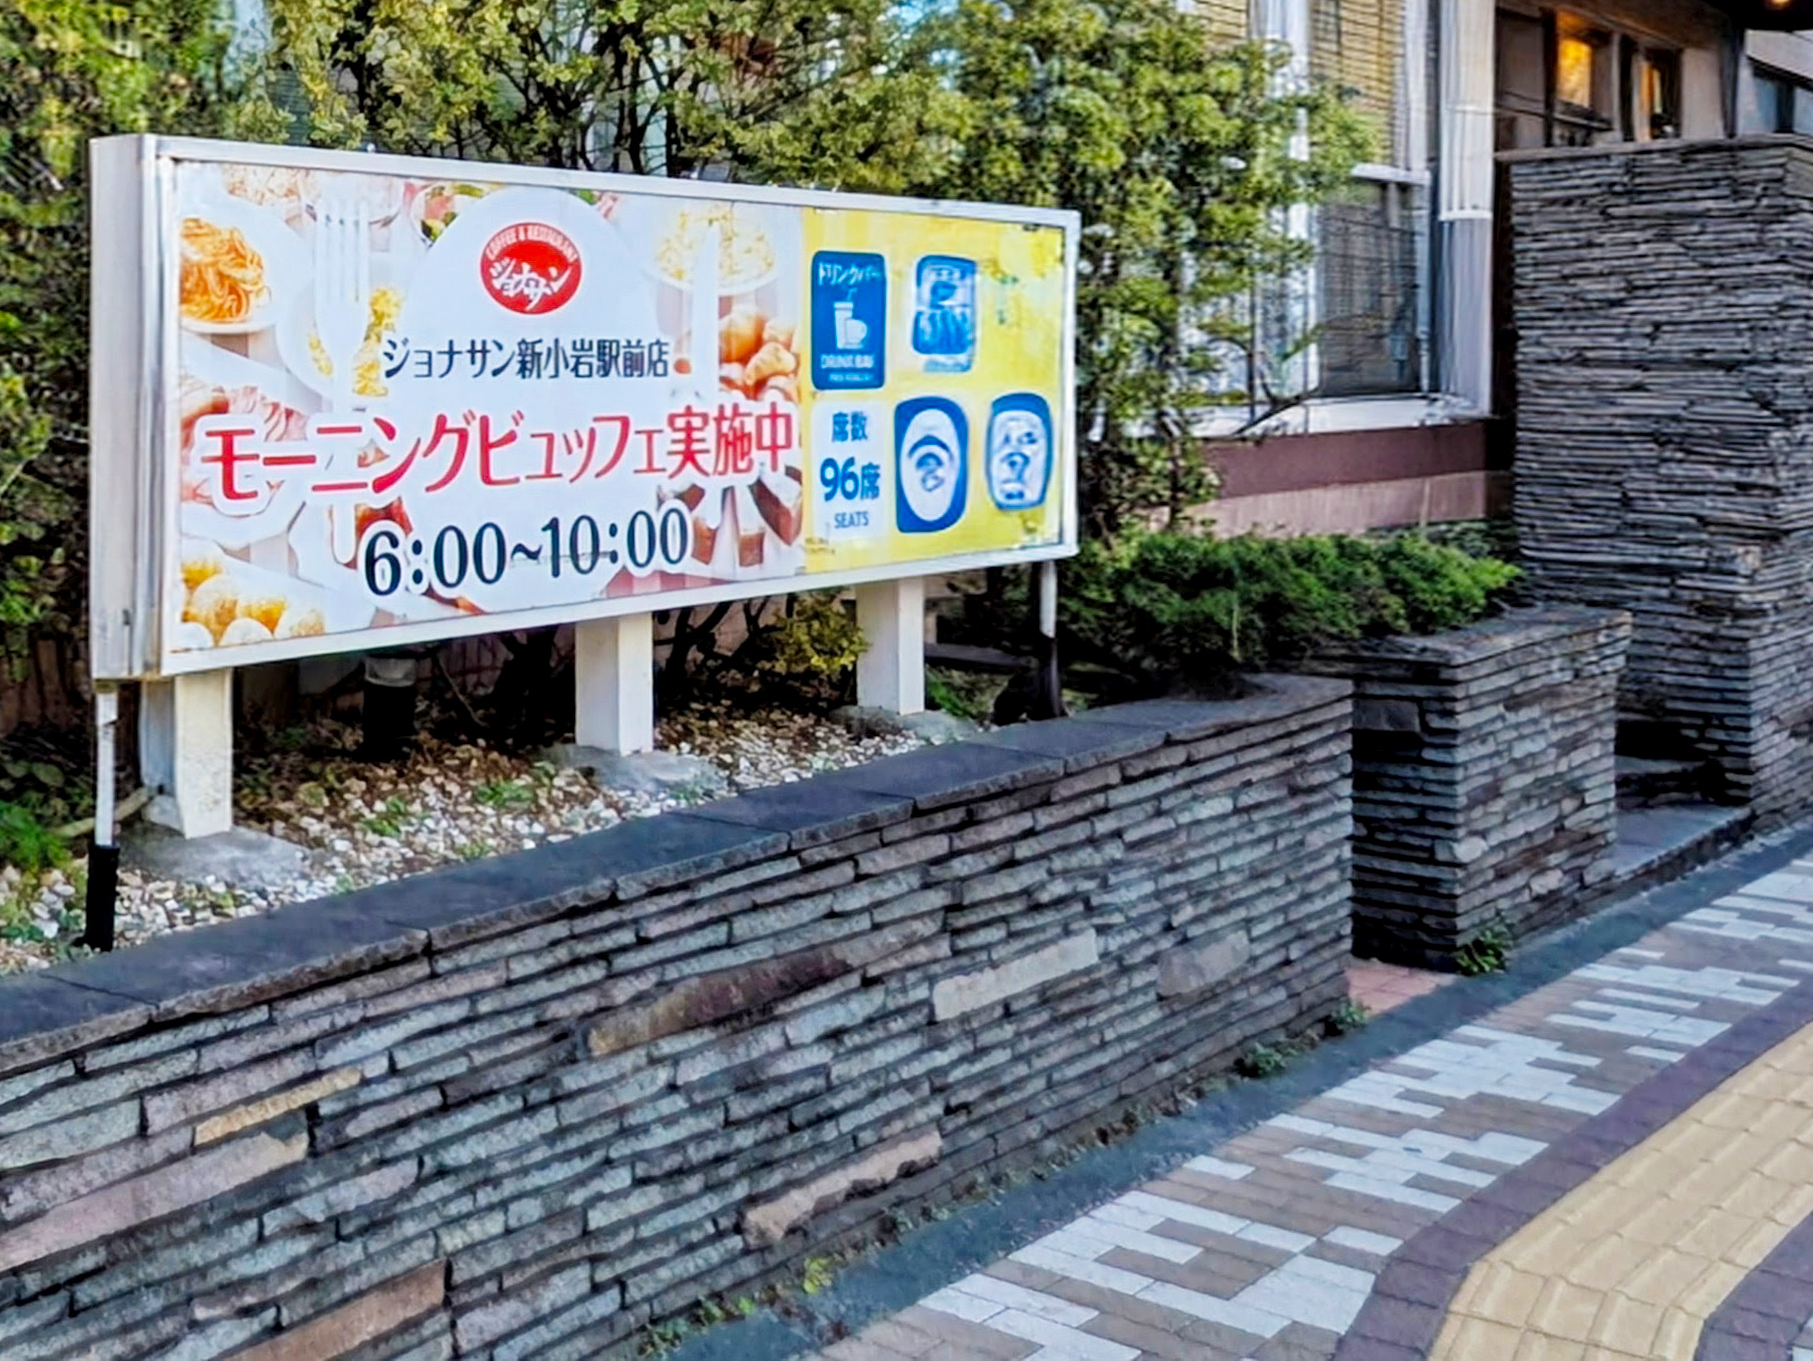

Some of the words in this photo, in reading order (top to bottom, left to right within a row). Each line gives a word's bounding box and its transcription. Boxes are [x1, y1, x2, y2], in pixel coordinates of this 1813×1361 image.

[382, 336, 670, 381] ジョナサン新小岩駅前店
[831, 411, 869, 442] 席数
[200, 401, 794, 501] モーニングビュッフェ実施中
[819, 456, 881, 502] 96席
[833, 511, 869, 529] SEATS
